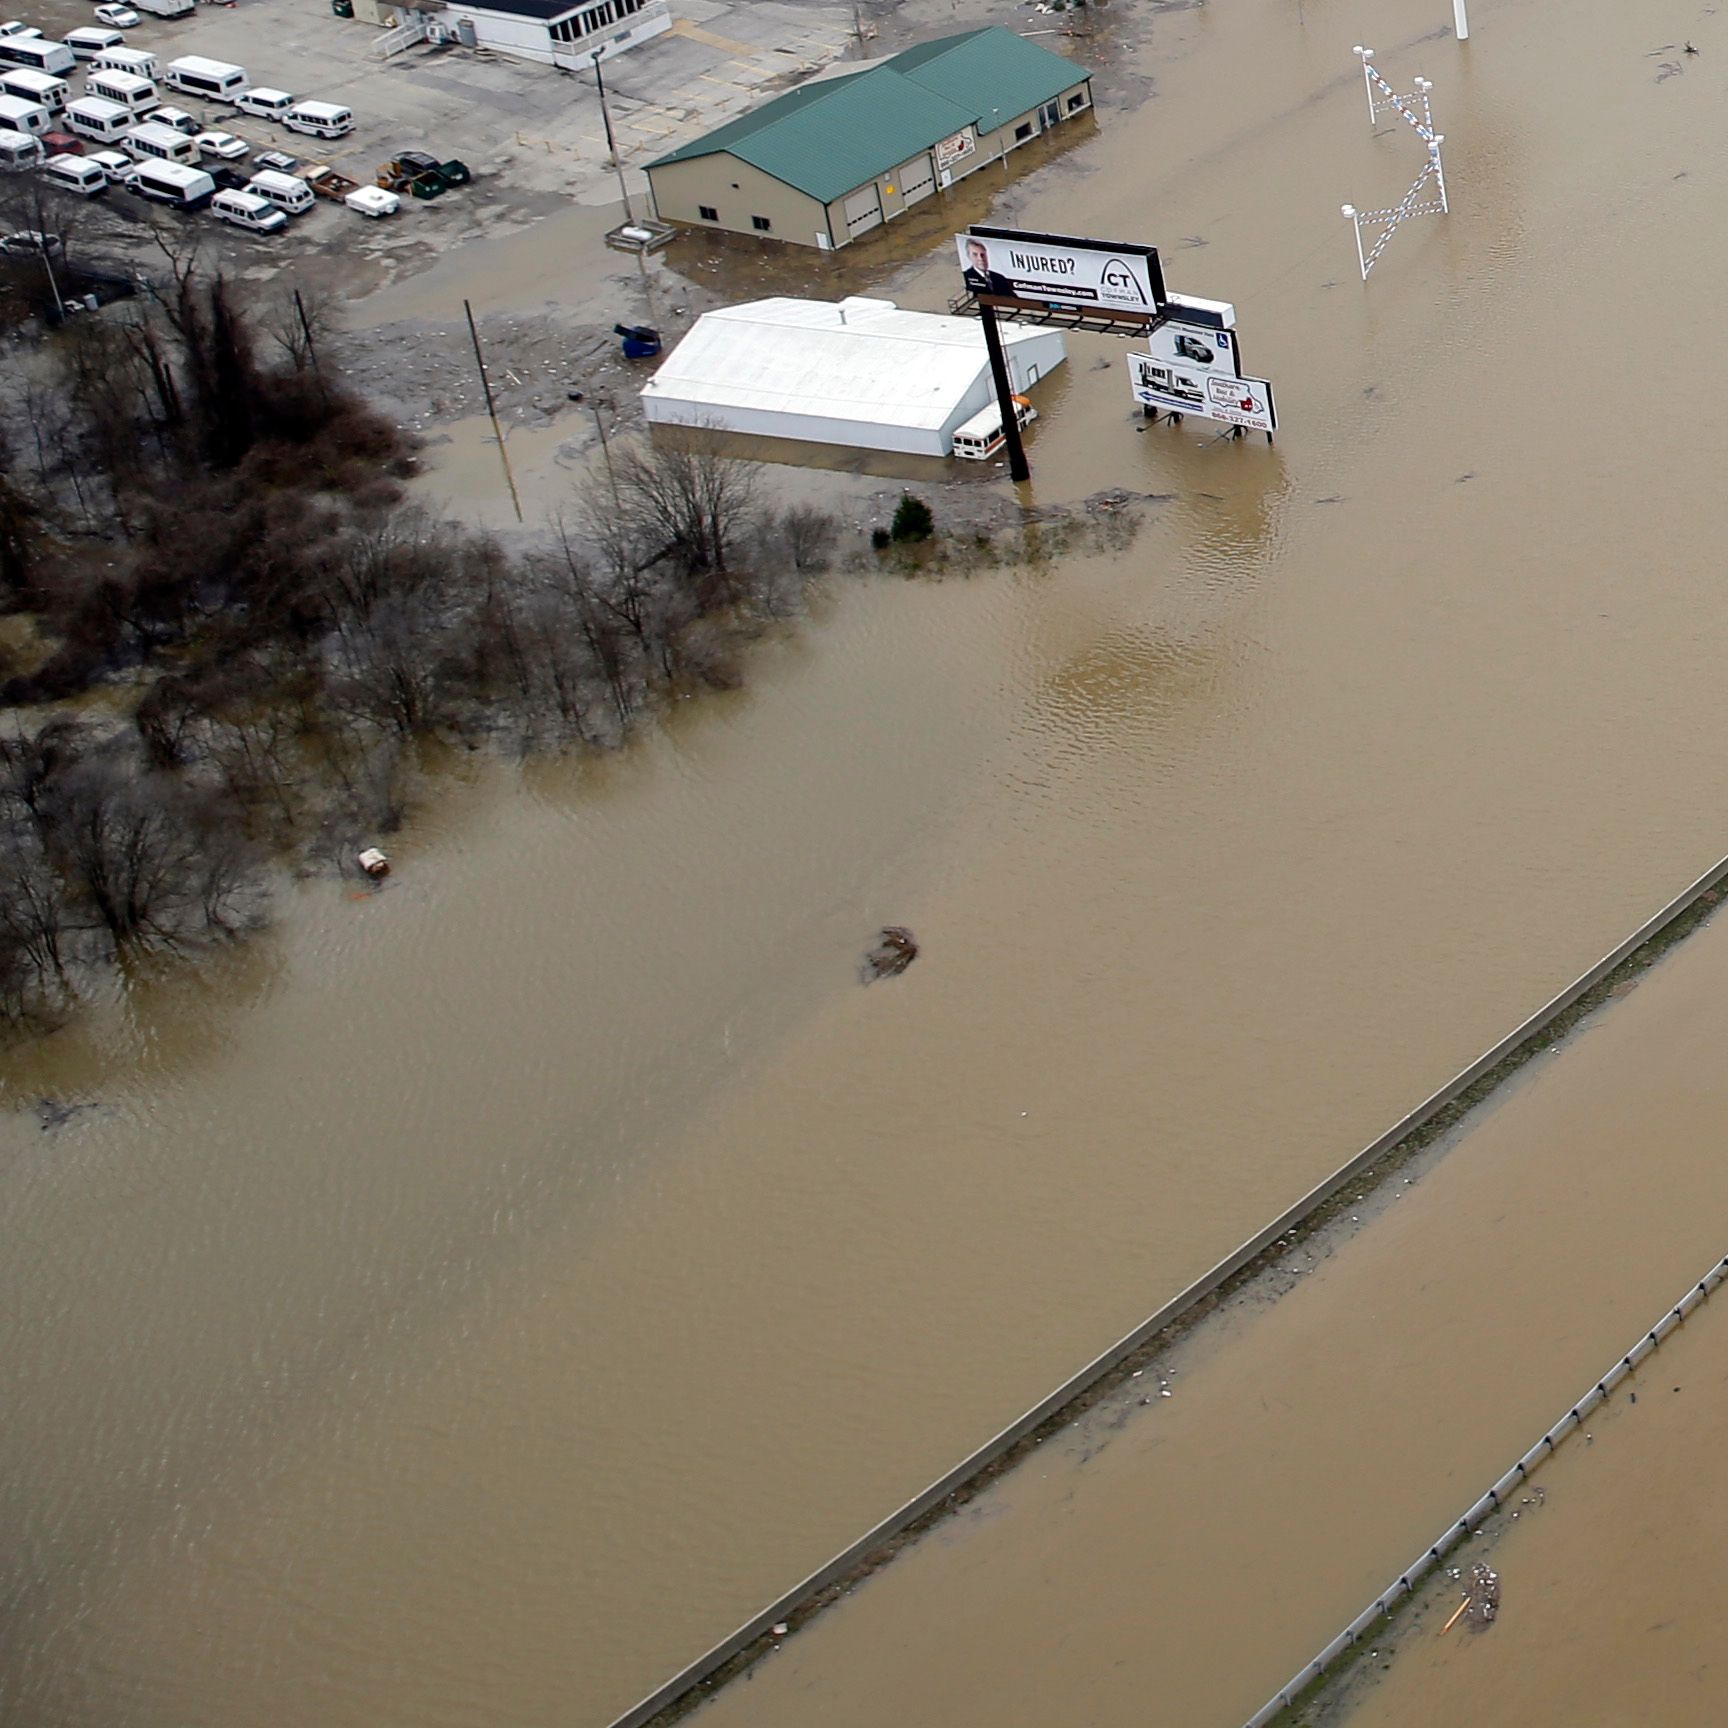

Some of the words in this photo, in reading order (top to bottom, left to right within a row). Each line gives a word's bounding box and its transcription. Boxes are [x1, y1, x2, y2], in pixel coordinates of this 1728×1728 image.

[1106, 273, 1131, 289] CT
[1012, 281, 1095, 298] CofmanTownsley.com
[1101, 285, 1138, 295] COFMAN
[1102, 292, 1140, 303] TOWNSLEY
